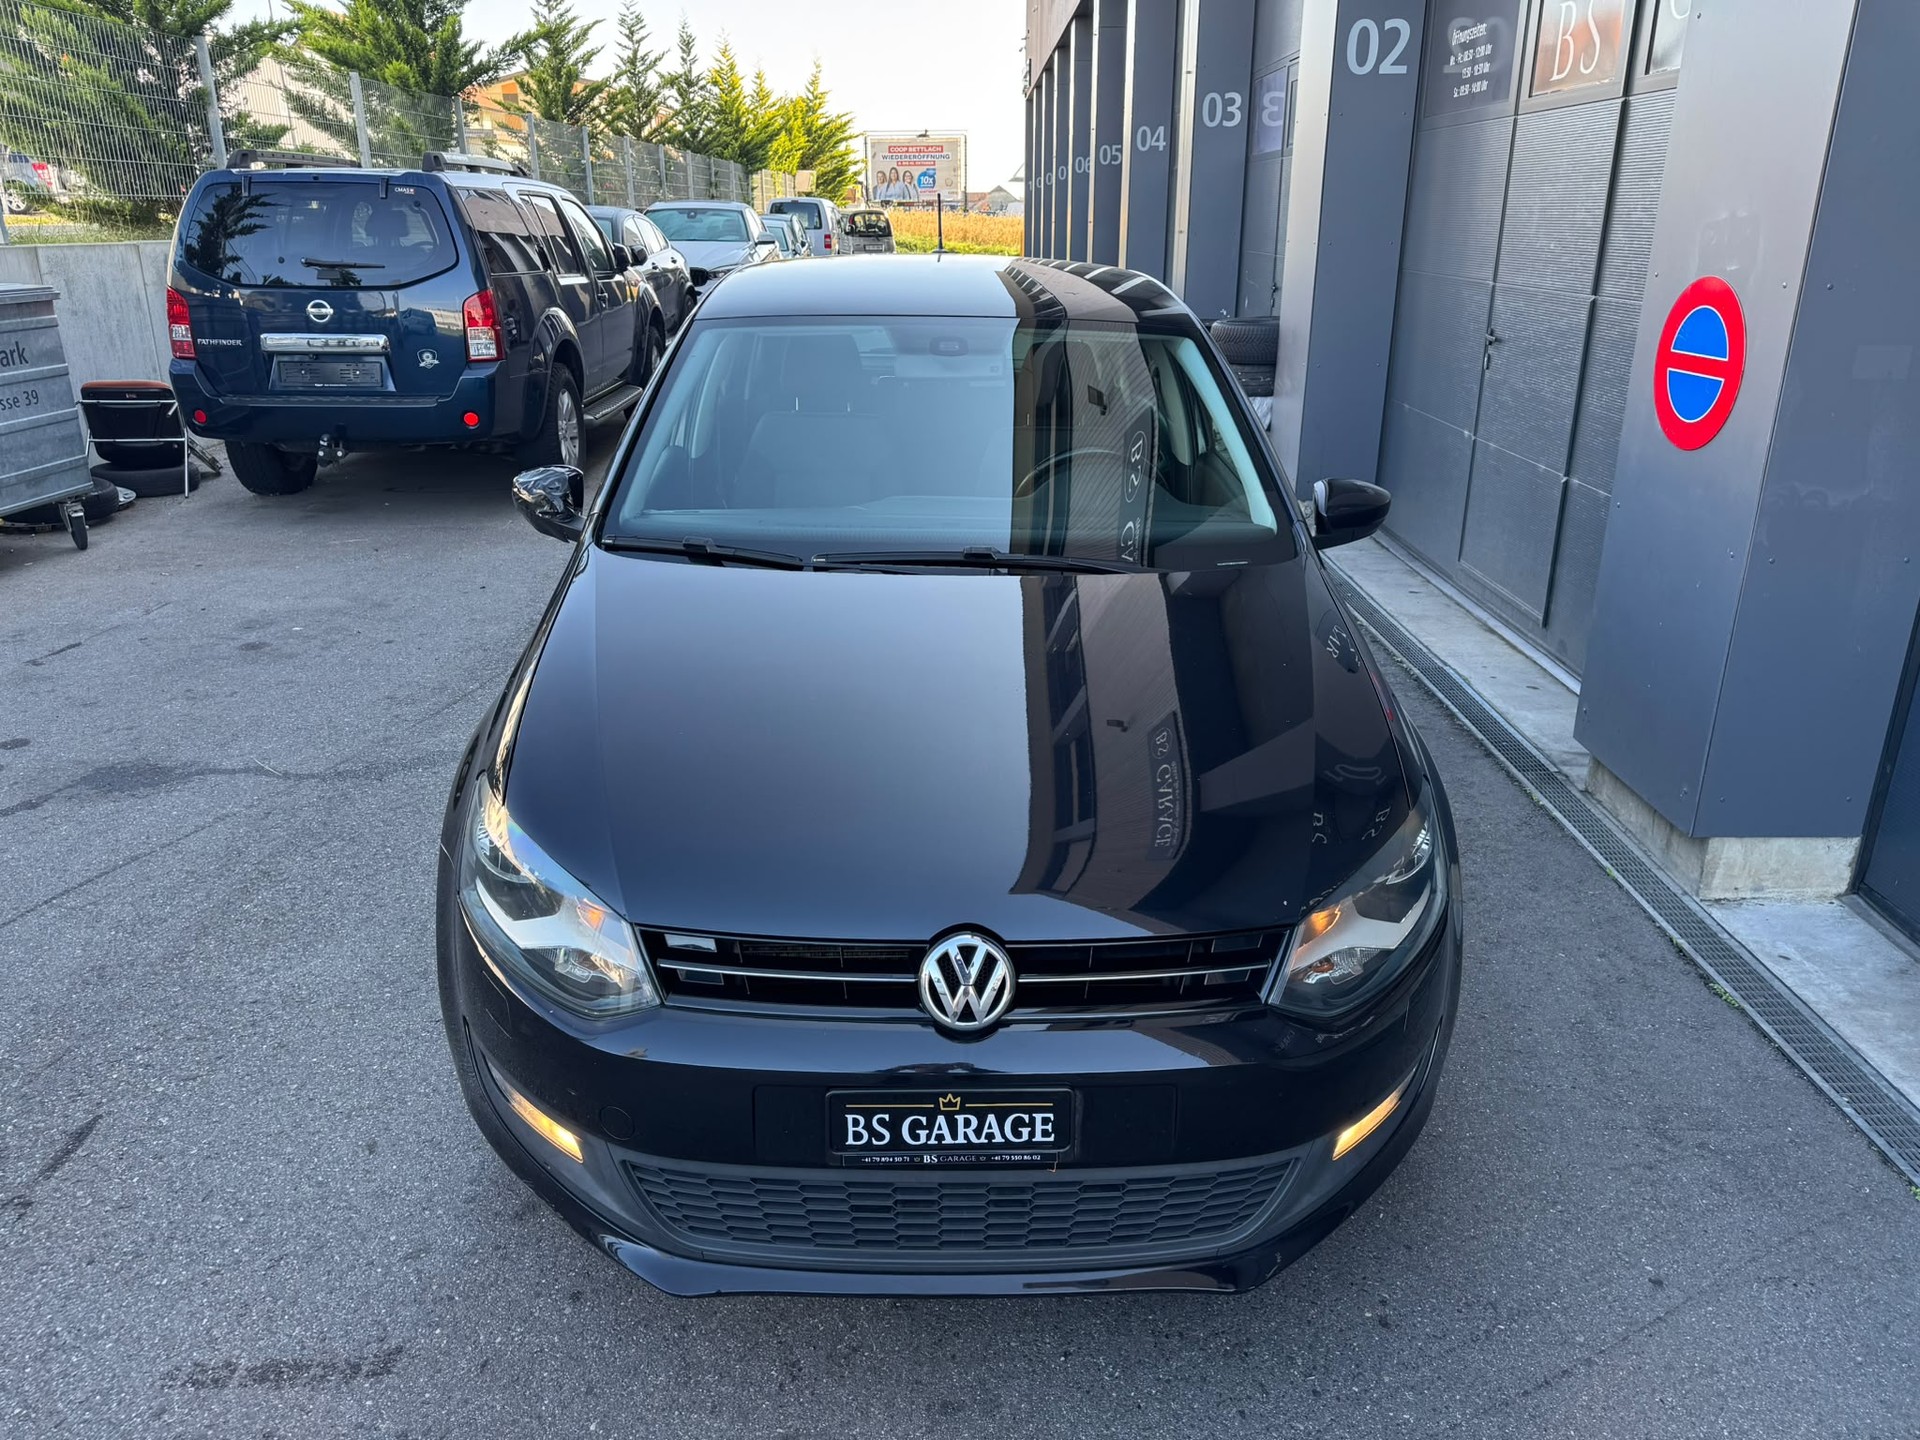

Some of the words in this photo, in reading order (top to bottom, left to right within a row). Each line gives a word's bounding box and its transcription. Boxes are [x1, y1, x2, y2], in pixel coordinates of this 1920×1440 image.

[1346, 18, 1411, 75] 02
[1549, 0, 1601, 81] BS
[1202, 91, 1242, 128] 03
[1136, 125, 1167, 151] 04
[1099, 144, 1122, 165] 05
[197, 337, 243, 347] PATHFINDER
[23, 389, 39, 406] 39
[845, 1113, 891, 1146] BS
[901, 1112, 1056, 1145] GARAGE
[923, 1154, 938, 1164] BS
[939, 1155, 977, 1163] GARAGE
